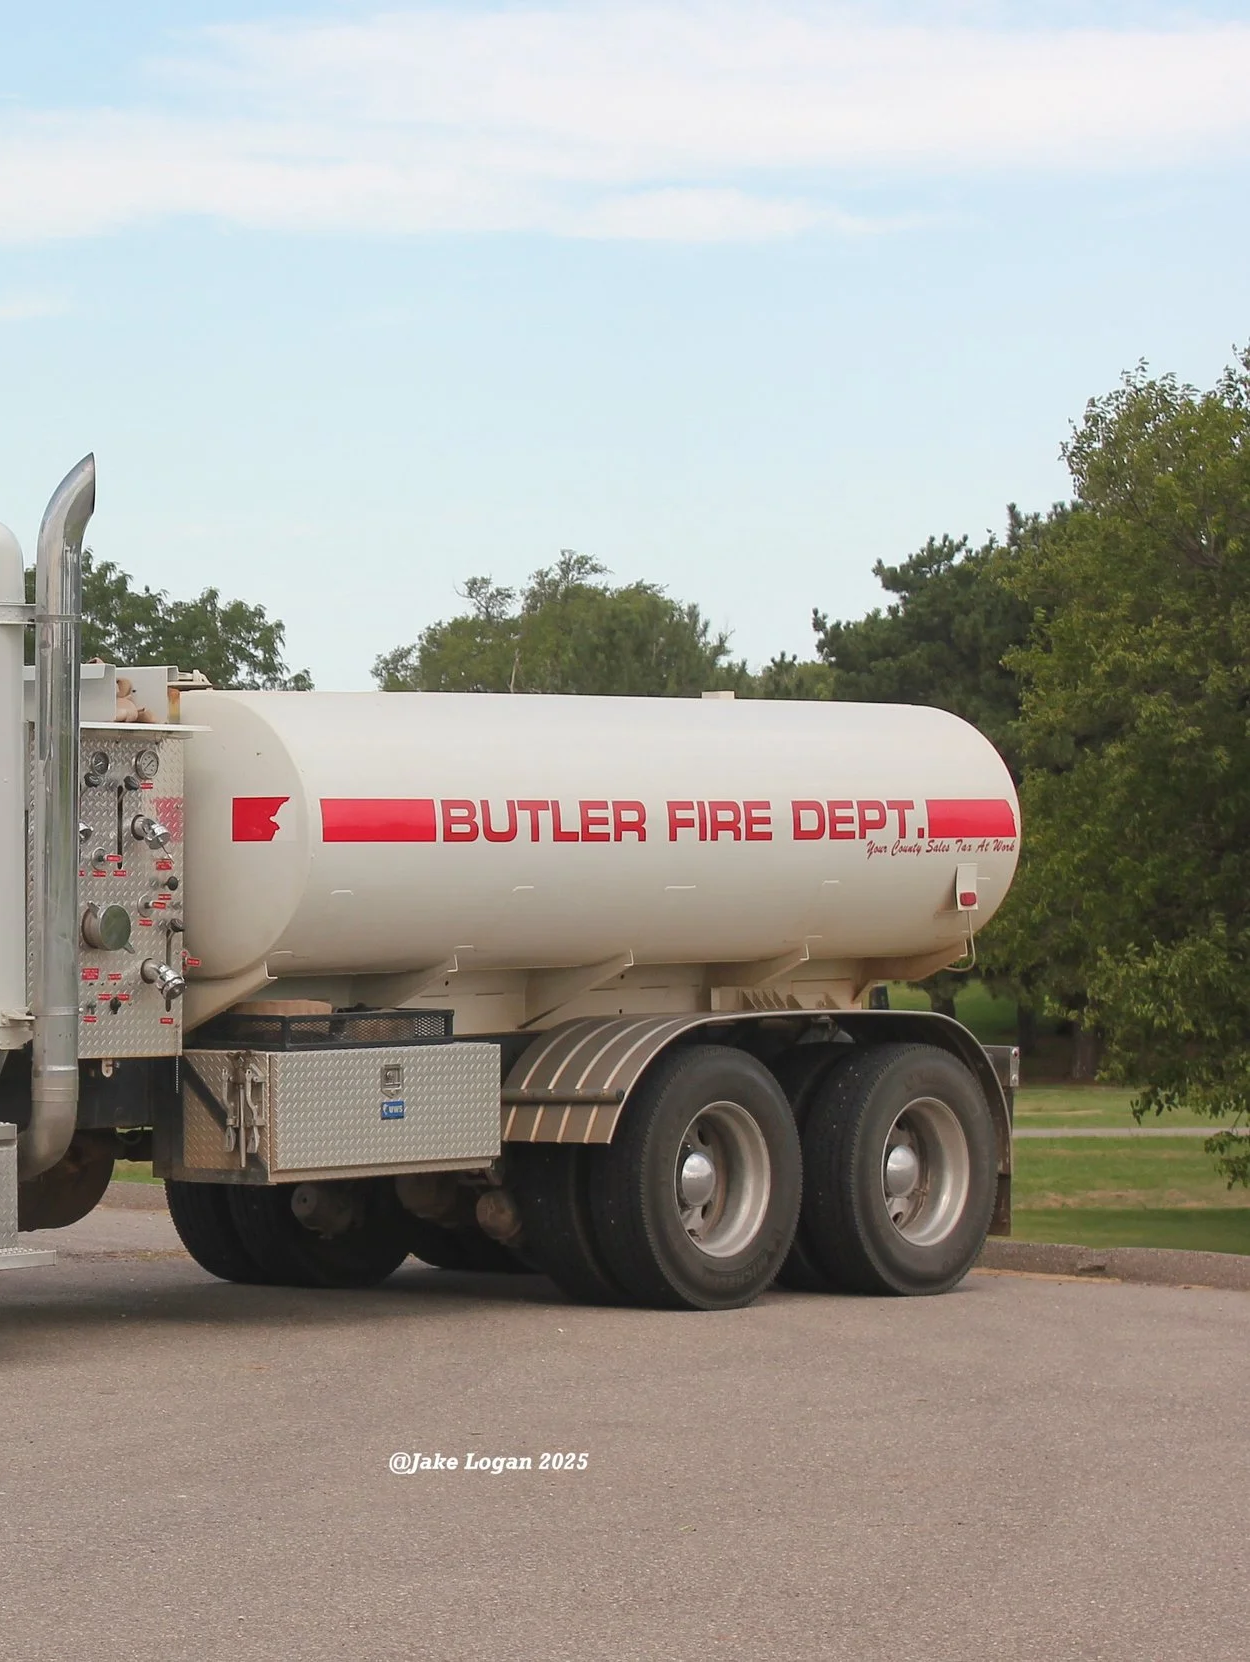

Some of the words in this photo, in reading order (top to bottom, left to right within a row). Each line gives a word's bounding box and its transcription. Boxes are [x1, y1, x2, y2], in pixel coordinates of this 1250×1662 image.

[441, 799, 647, 842] BUTLER
[666, 799, 773, 842] FIRE
[791, 799, 925, 841] DEPT.
[866, 840, 888, 860] Your
[890, 839, 922, 857] County
[925, 839, 950, 853] Sales
[955, 839, 972, 852] Tax
[975, 839, 990, 853] At
[992, 839, 1015, 852] Work
